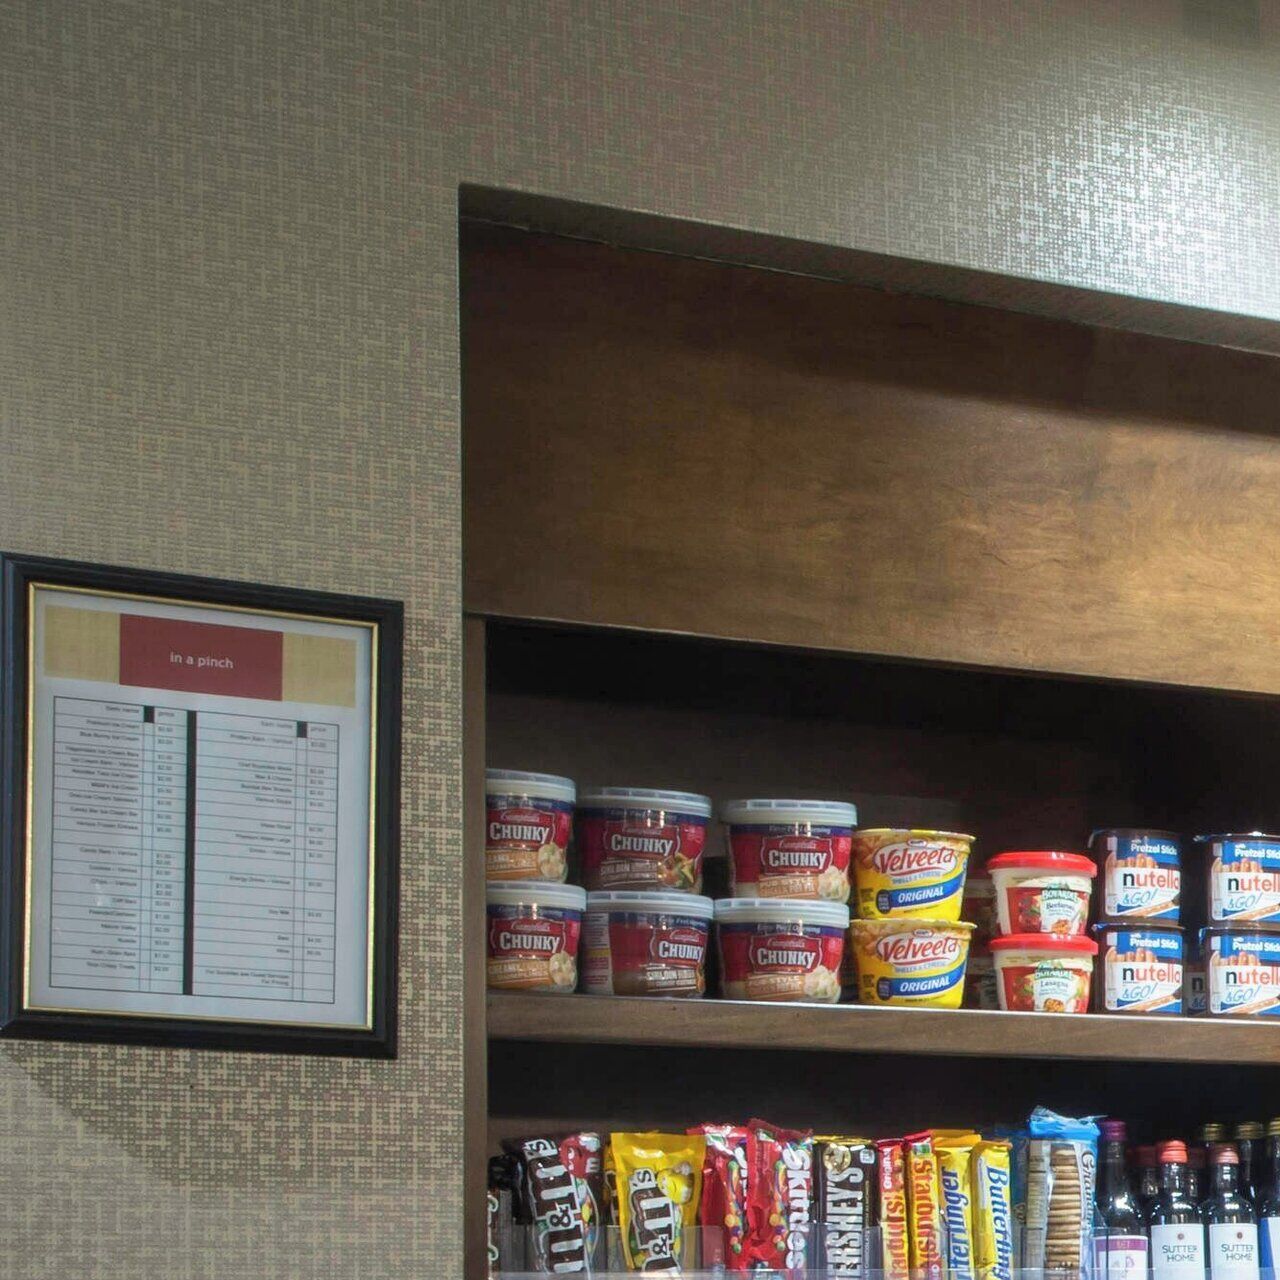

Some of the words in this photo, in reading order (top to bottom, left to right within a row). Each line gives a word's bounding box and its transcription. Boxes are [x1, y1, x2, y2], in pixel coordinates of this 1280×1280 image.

[197, 653, 234, 672] pinch
[879, 847, 955, 874] Velveeta
[898, 886, 944, 903] ORIGINAL
[882, 936, 959, 962] Velveeta
[900, 975, 950, 992] ORIGINAL
[1166, 1253, 1196, 1263] HOME
[1225, 1252, 1254, 1261] HOME
